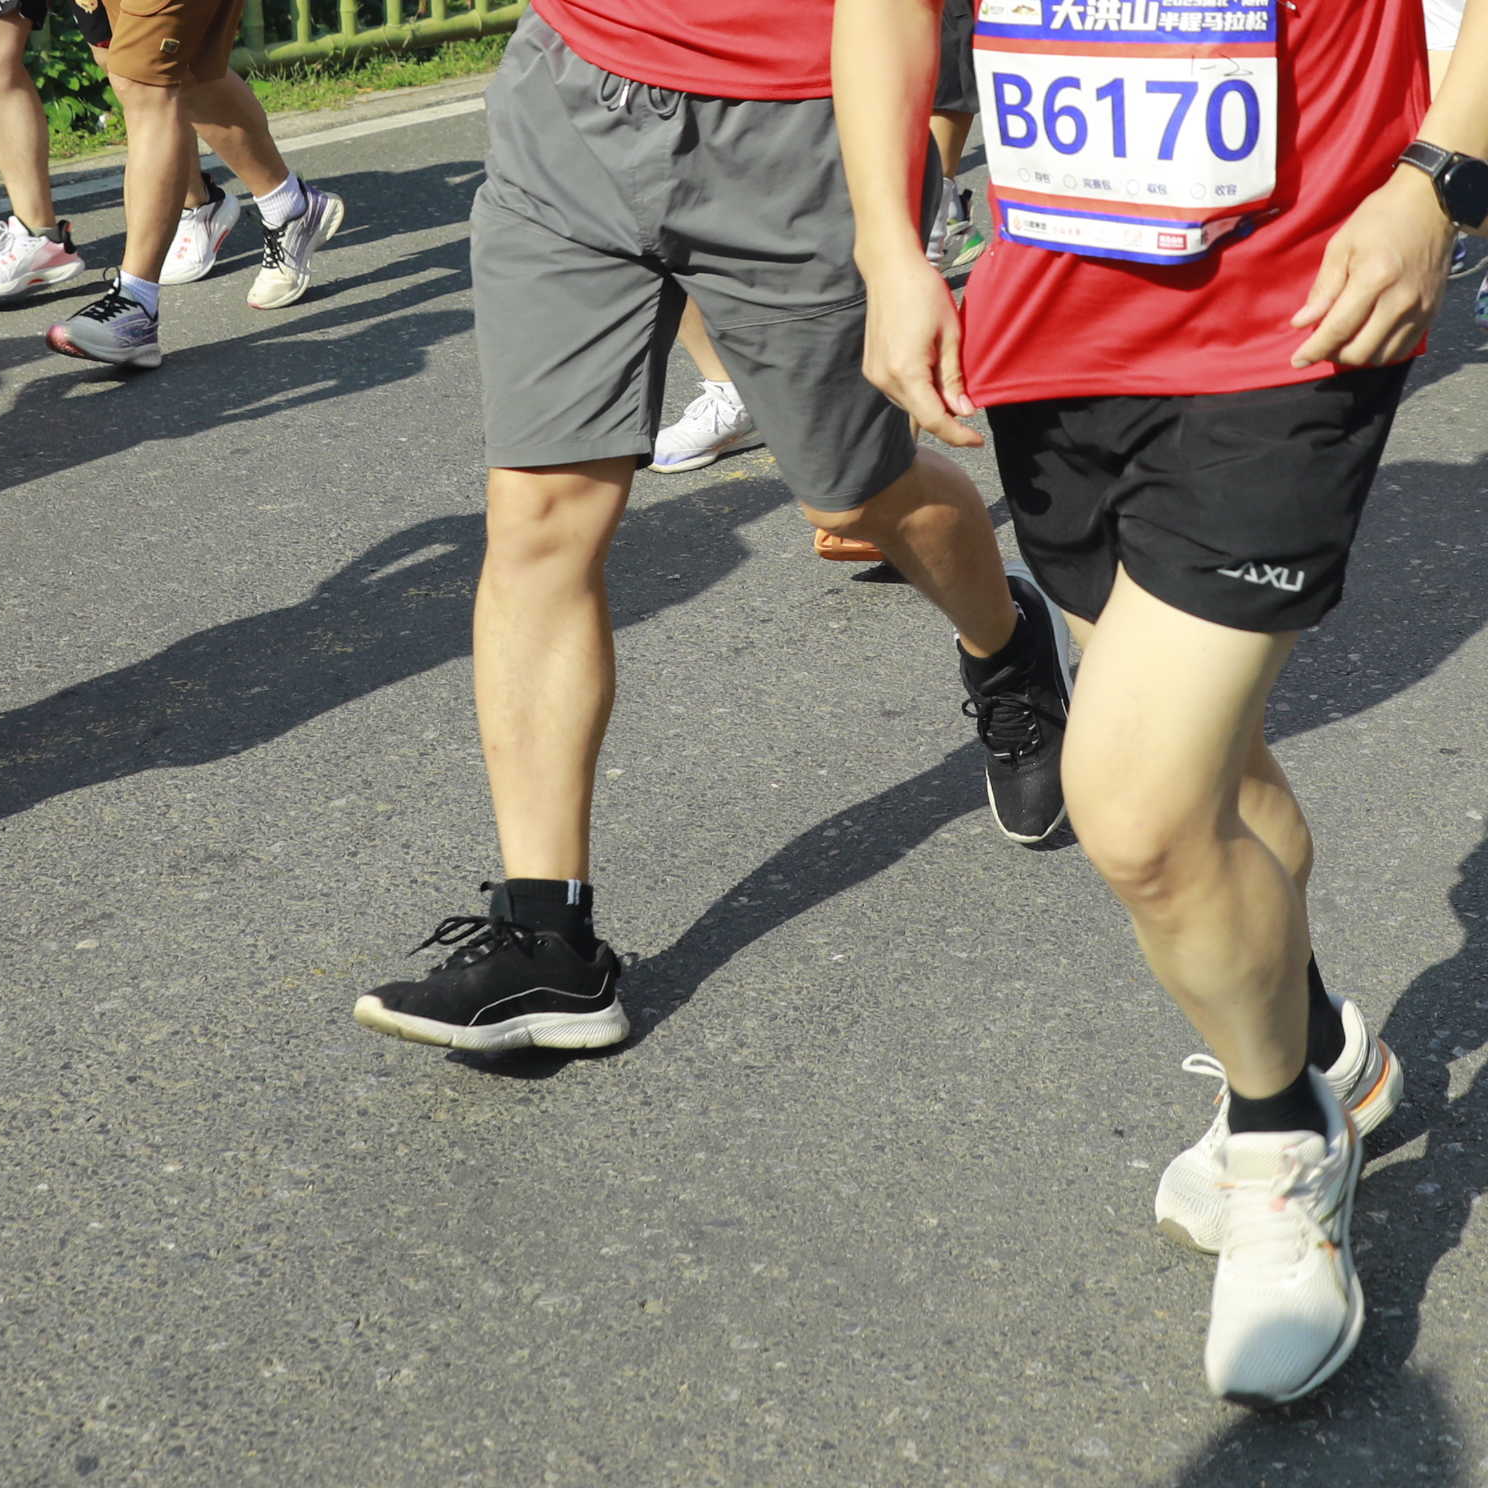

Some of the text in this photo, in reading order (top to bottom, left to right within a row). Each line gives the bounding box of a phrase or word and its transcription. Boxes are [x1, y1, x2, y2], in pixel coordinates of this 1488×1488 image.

[1158, 11, 1267, 32] 半程马拉松
[992, 71, 1260, 162] B6170
